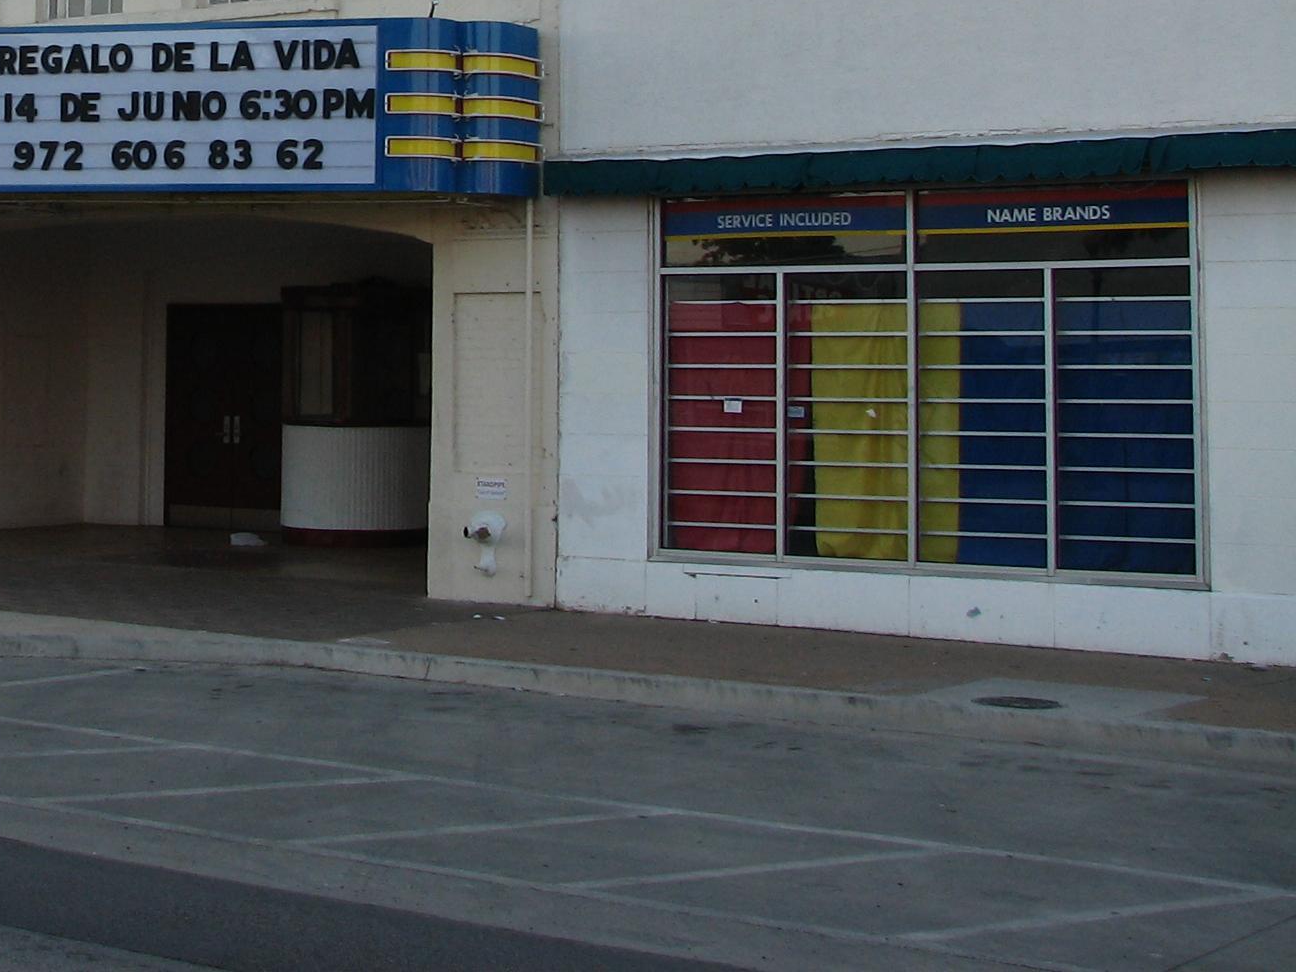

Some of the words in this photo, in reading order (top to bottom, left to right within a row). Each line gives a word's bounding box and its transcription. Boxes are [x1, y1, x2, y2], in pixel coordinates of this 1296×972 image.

[151, 42, 195, 73] DE
[210, 41, 255, 71] LA
[273, 38, 360, 70] VIDA
[4, 93, 38, 122] 14
[60, 92, 101, 122] DE
[239, 89, 317, 120] 6:30
[322, 88, 376, 119] PM
[13, 141, 84, 171] 972
[111, 140, 186, 170] 606
[208, 139, 253, 170] 83
[276, 138, 324, 170] 62
[717, 214, 773, 229] SERVICE
[779, 212, 852, 227] INCLUDED
[987, 208, 1037, 223] NAME
[1043, 205, 1110, 221] BRANDS
